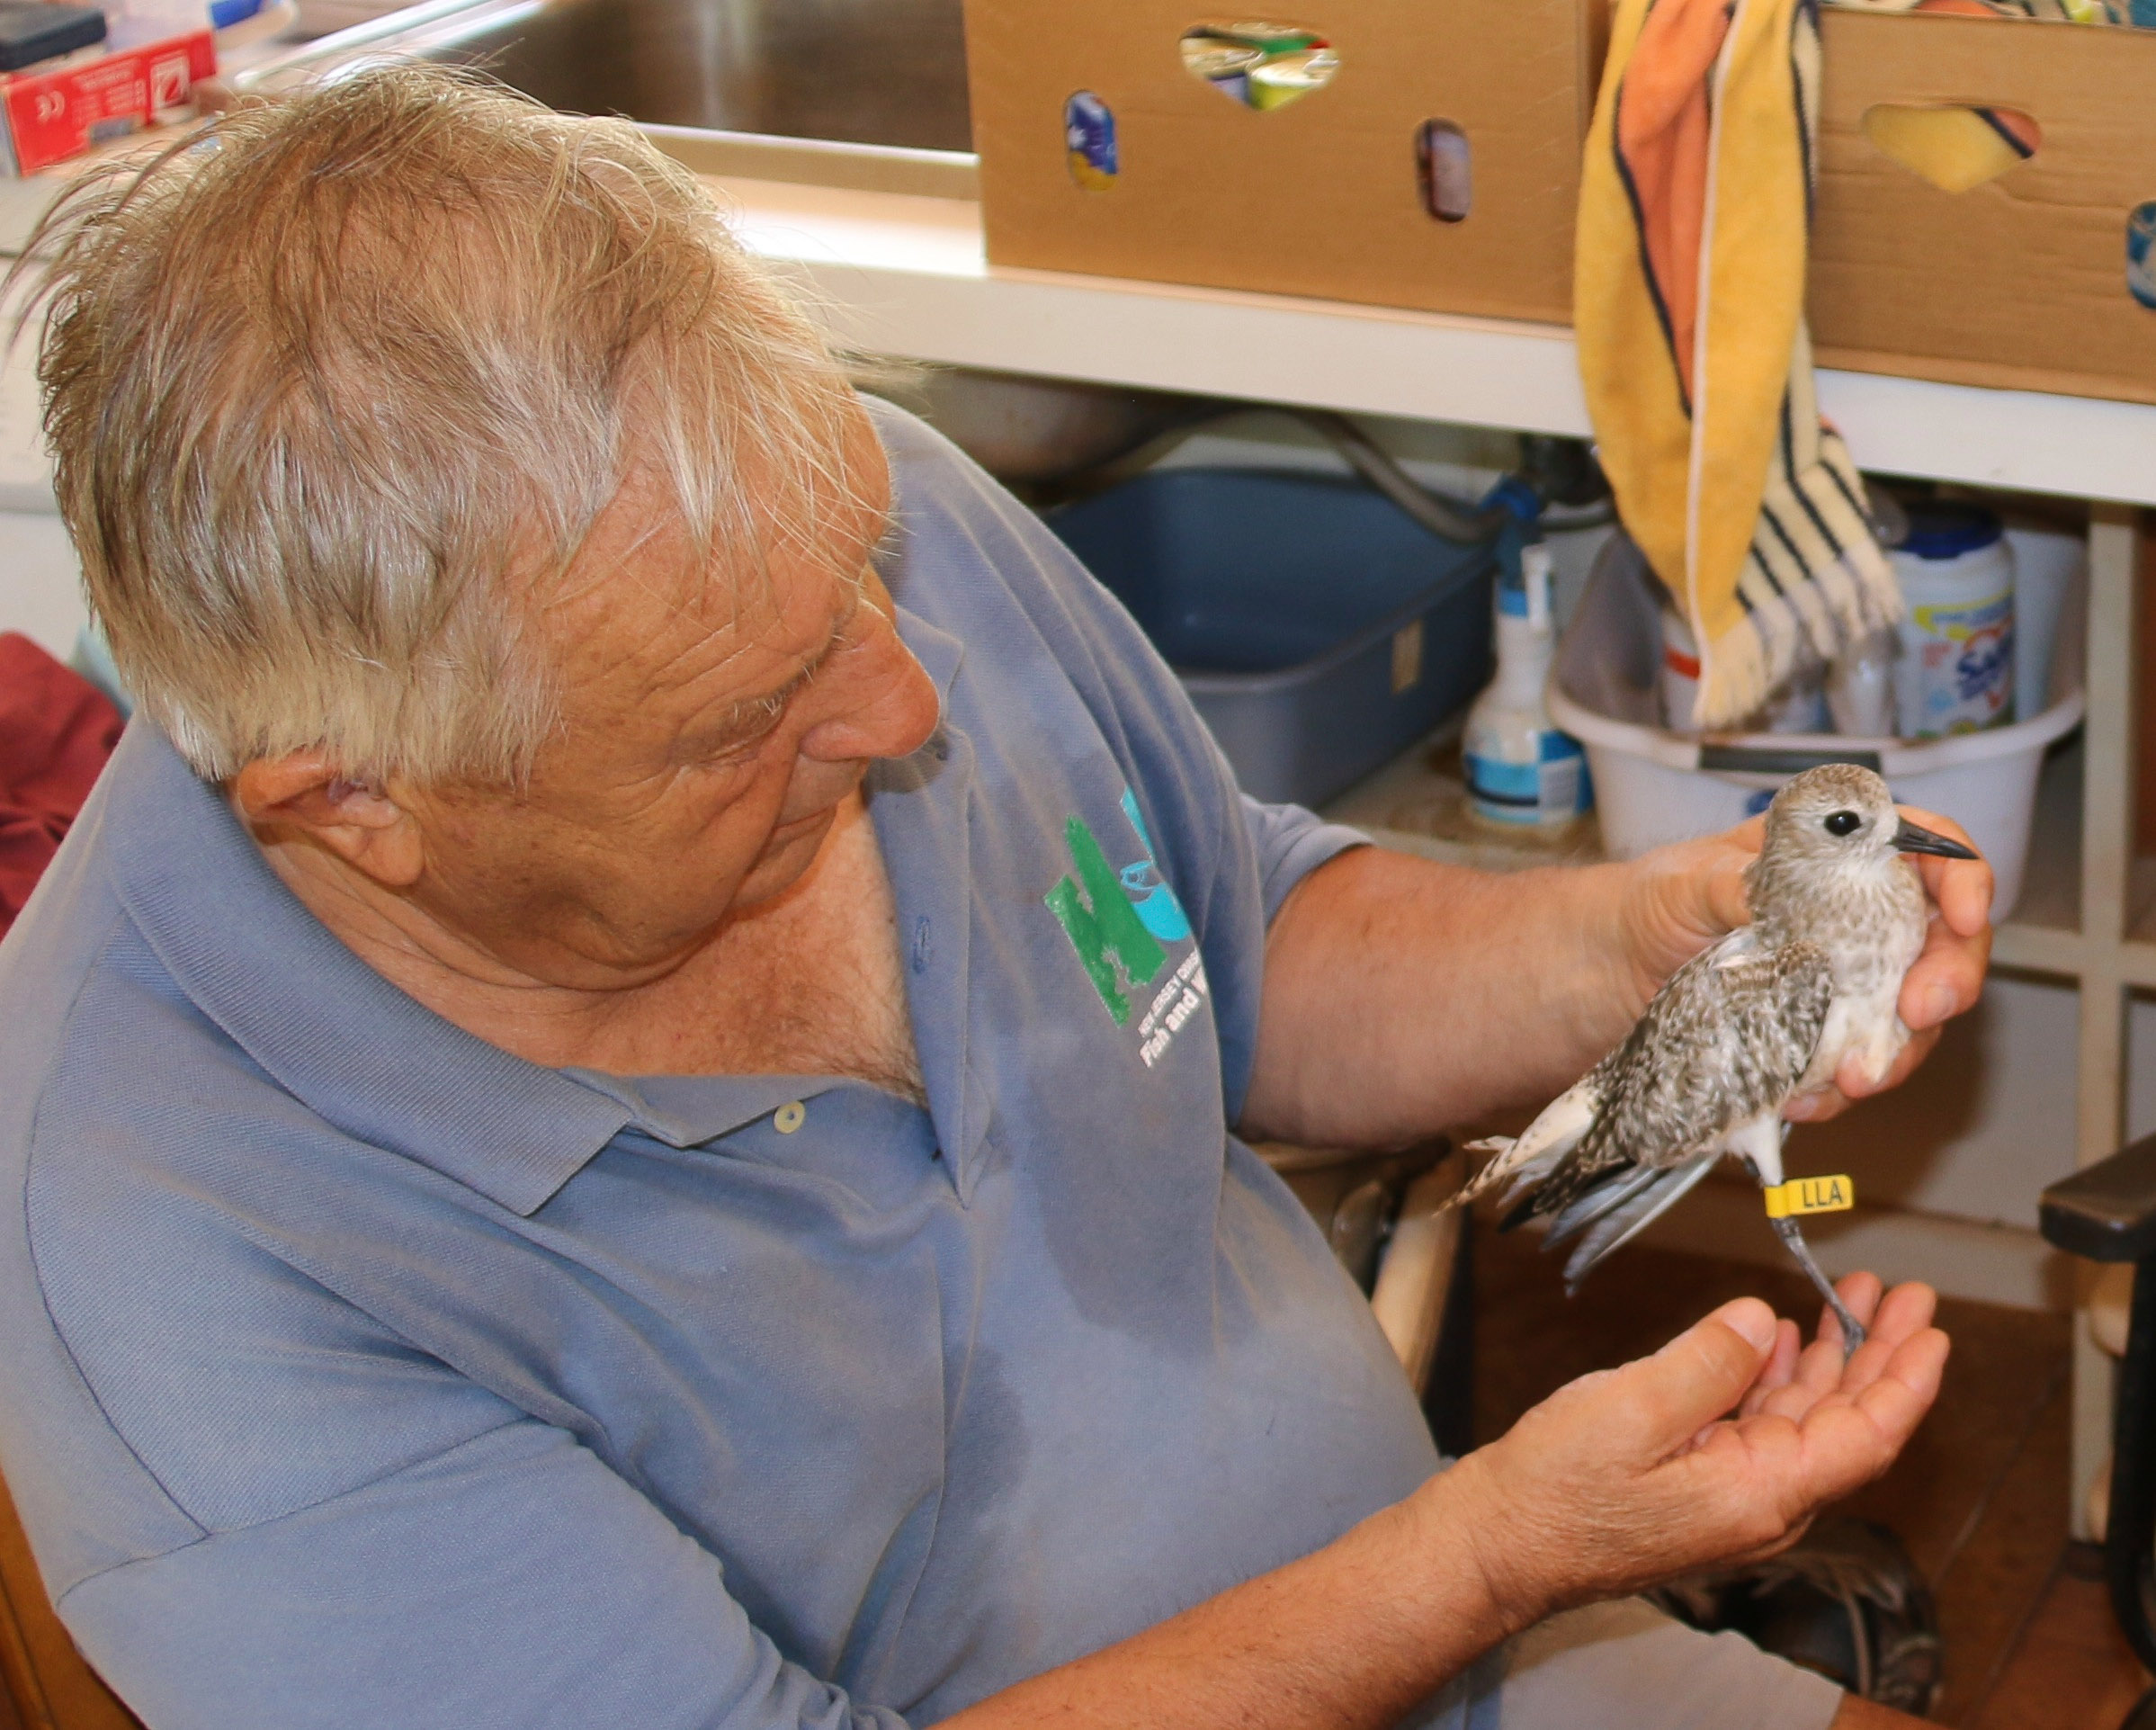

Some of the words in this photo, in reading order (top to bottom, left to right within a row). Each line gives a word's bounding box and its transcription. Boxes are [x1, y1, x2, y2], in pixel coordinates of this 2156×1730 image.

[1139, 1012, 1155, 1038] NEW
[1151, 975, 1182, 1017] JERSEY
[1141, 1028, 1171, 1068] Fish
[1166, 988, 1199, 1032] and
[1803, 1180, 1842, 1207] LLA
